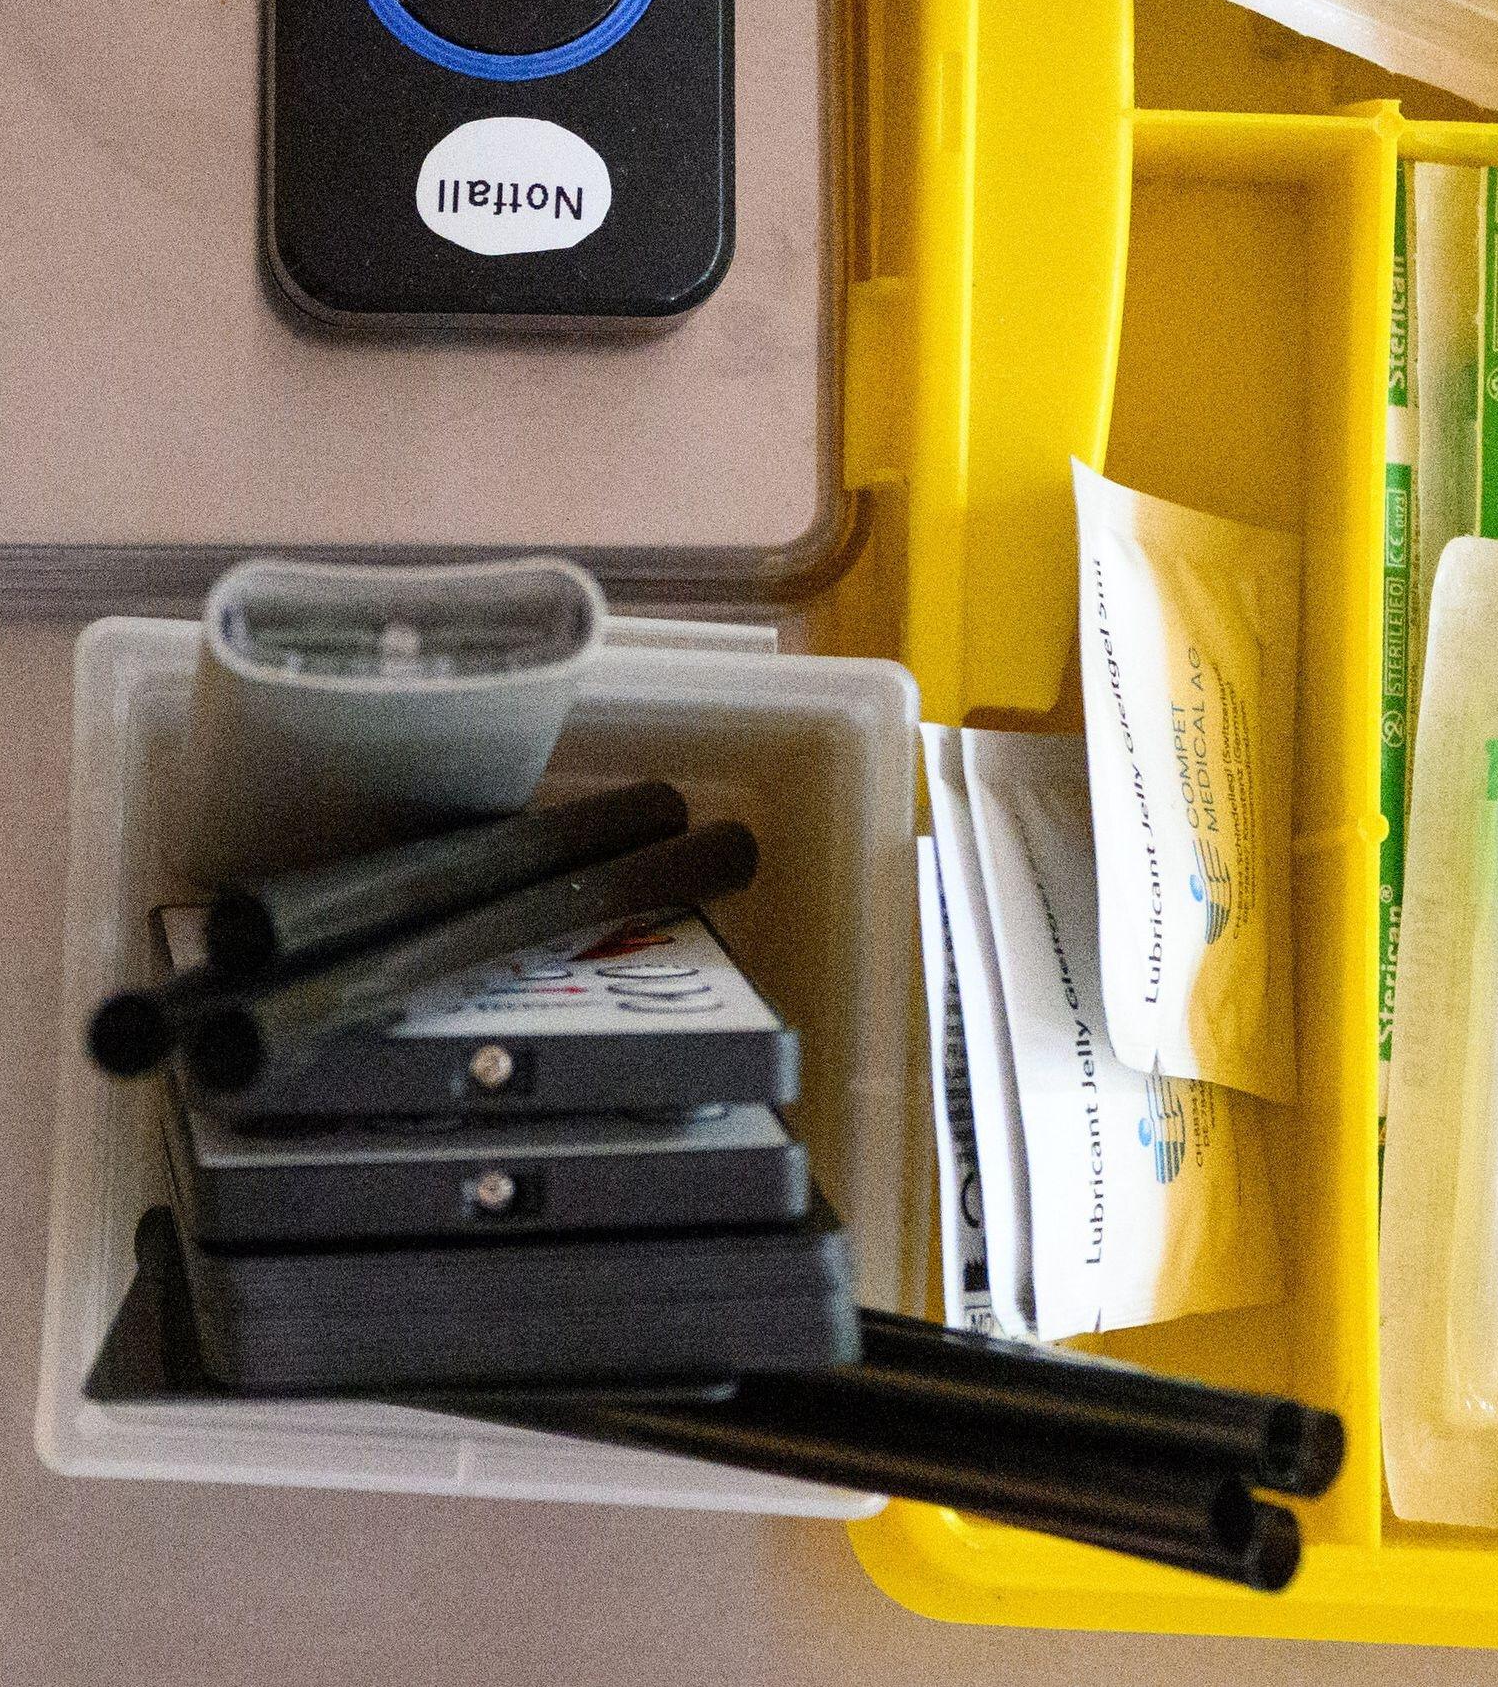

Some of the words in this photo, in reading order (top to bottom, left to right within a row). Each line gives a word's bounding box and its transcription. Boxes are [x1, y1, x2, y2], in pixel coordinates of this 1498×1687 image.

[438, 179, 584, 220] Notfall
[1386, 613, 1402, 692] STERILE
[1129, 760, 1153, 836] Jelly
[1170, 700, 1199, 828] COMPET
[1190, 699, 1219, 832] MEDICAL
[1140, 845, 1161, 1005] Lubricant
[1073, 1018, 1099, 1093] Jelly
[1081, 1100, 1101, 1264] Lubricant
